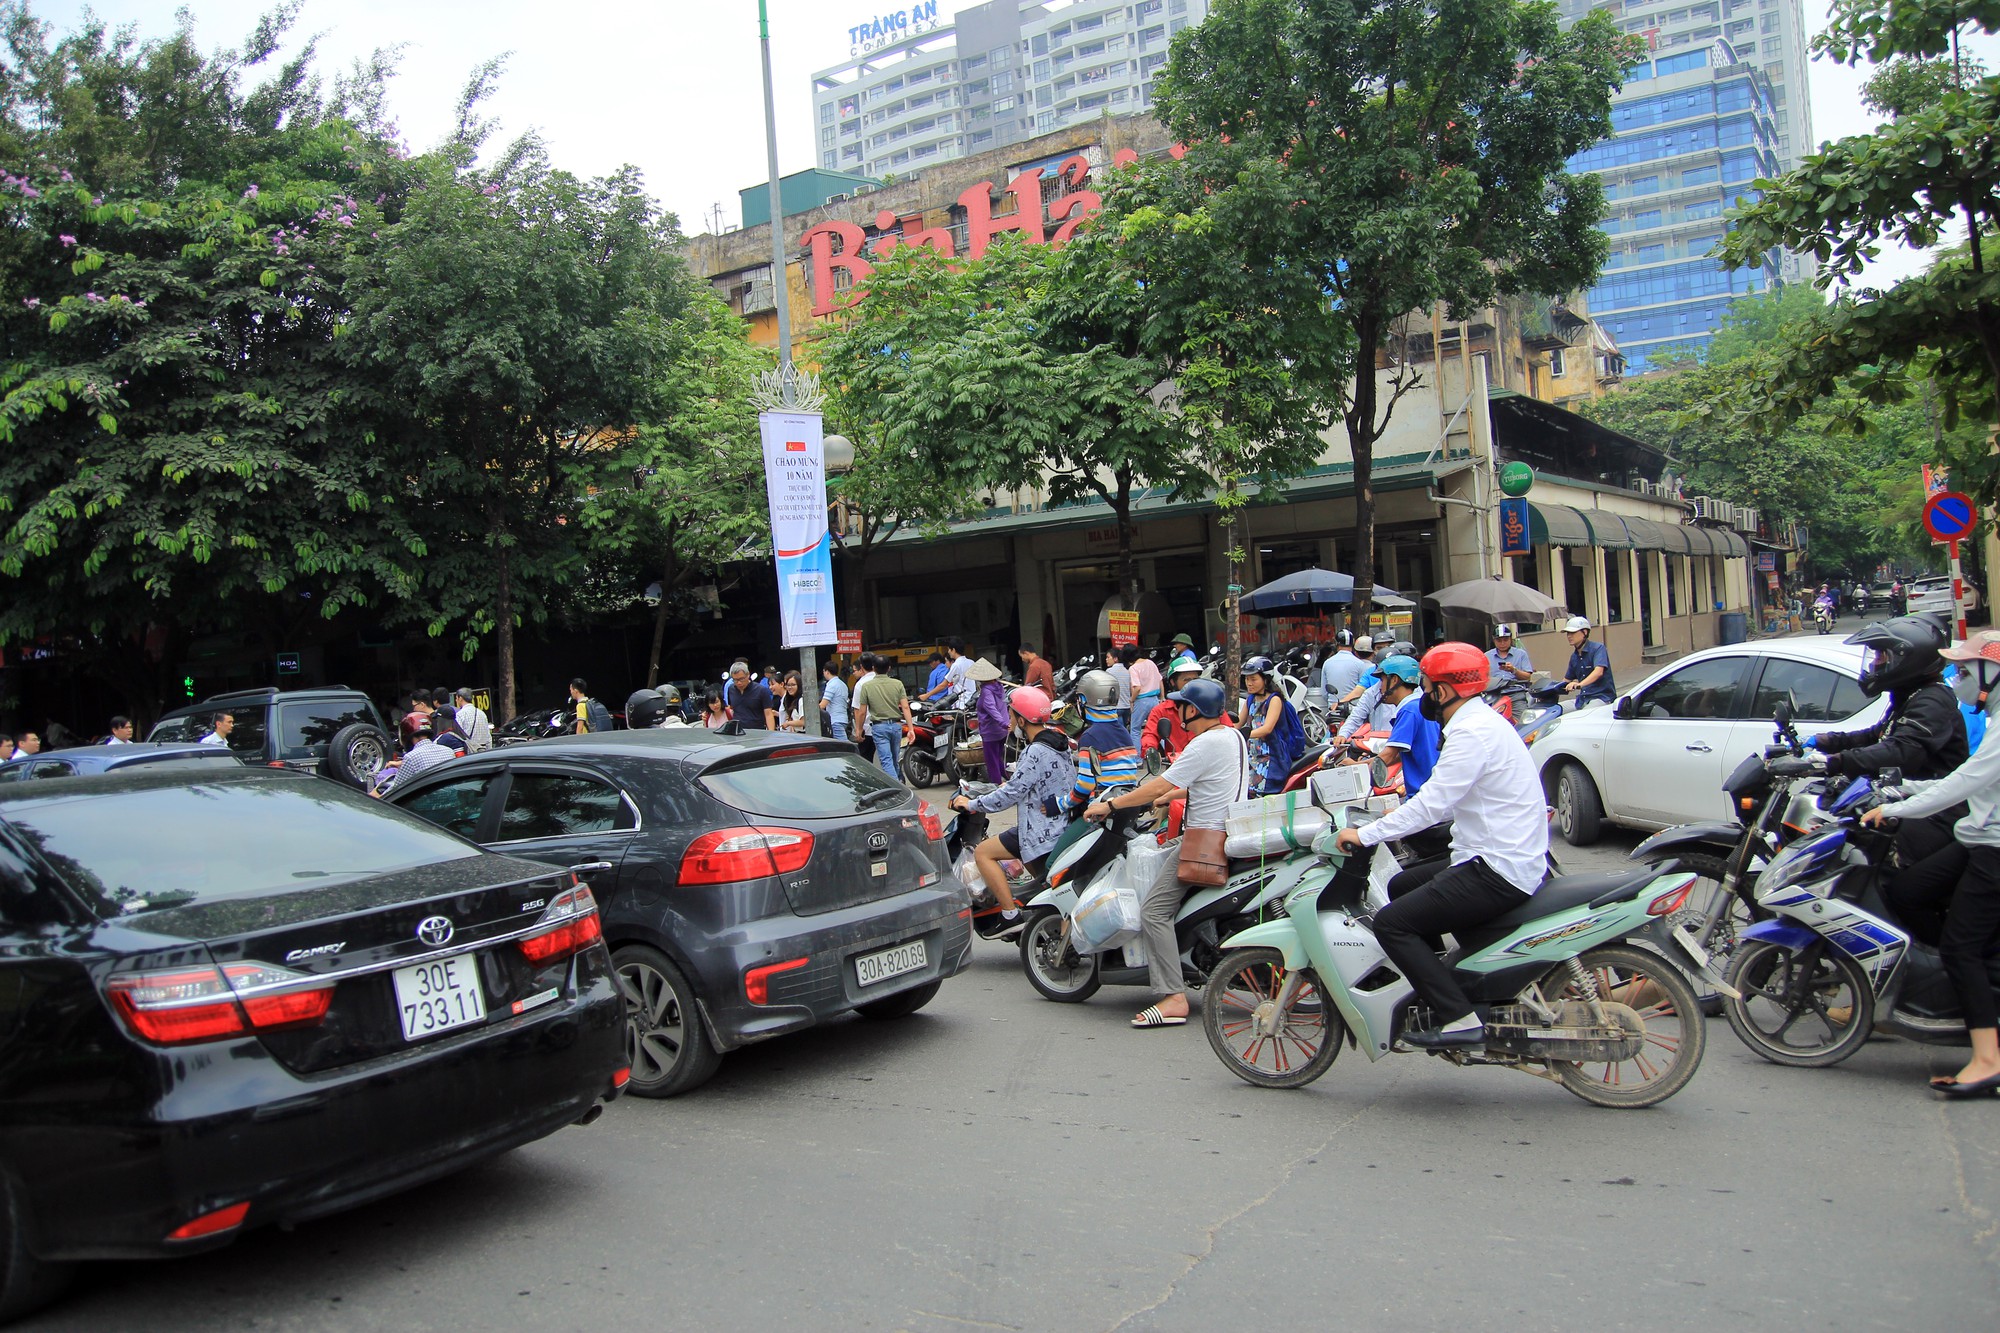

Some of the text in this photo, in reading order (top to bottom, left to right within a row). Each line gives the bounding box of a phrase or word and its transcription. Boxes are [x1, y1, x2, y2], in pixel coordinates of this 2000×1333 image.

[848, 0, 937, 44] TRÀNG AN
[850, 19, 937, 57] COMPLEX
[775, 455, 819, 467] CHÀO MỪNG
[786, 469, 813, 480] 10 NĂM
[1504, 472, 1528, 483] TUBORG
[1504, 509, 1524, 548] Tiger
[871, 834, 886, 846] KIA
[789, 879, 810, 889] RIO
[286, 941, 347, 962] CAMRY
[416, 960, 460, 996] 30E
[404, 989, 480, 1035] 733.11
